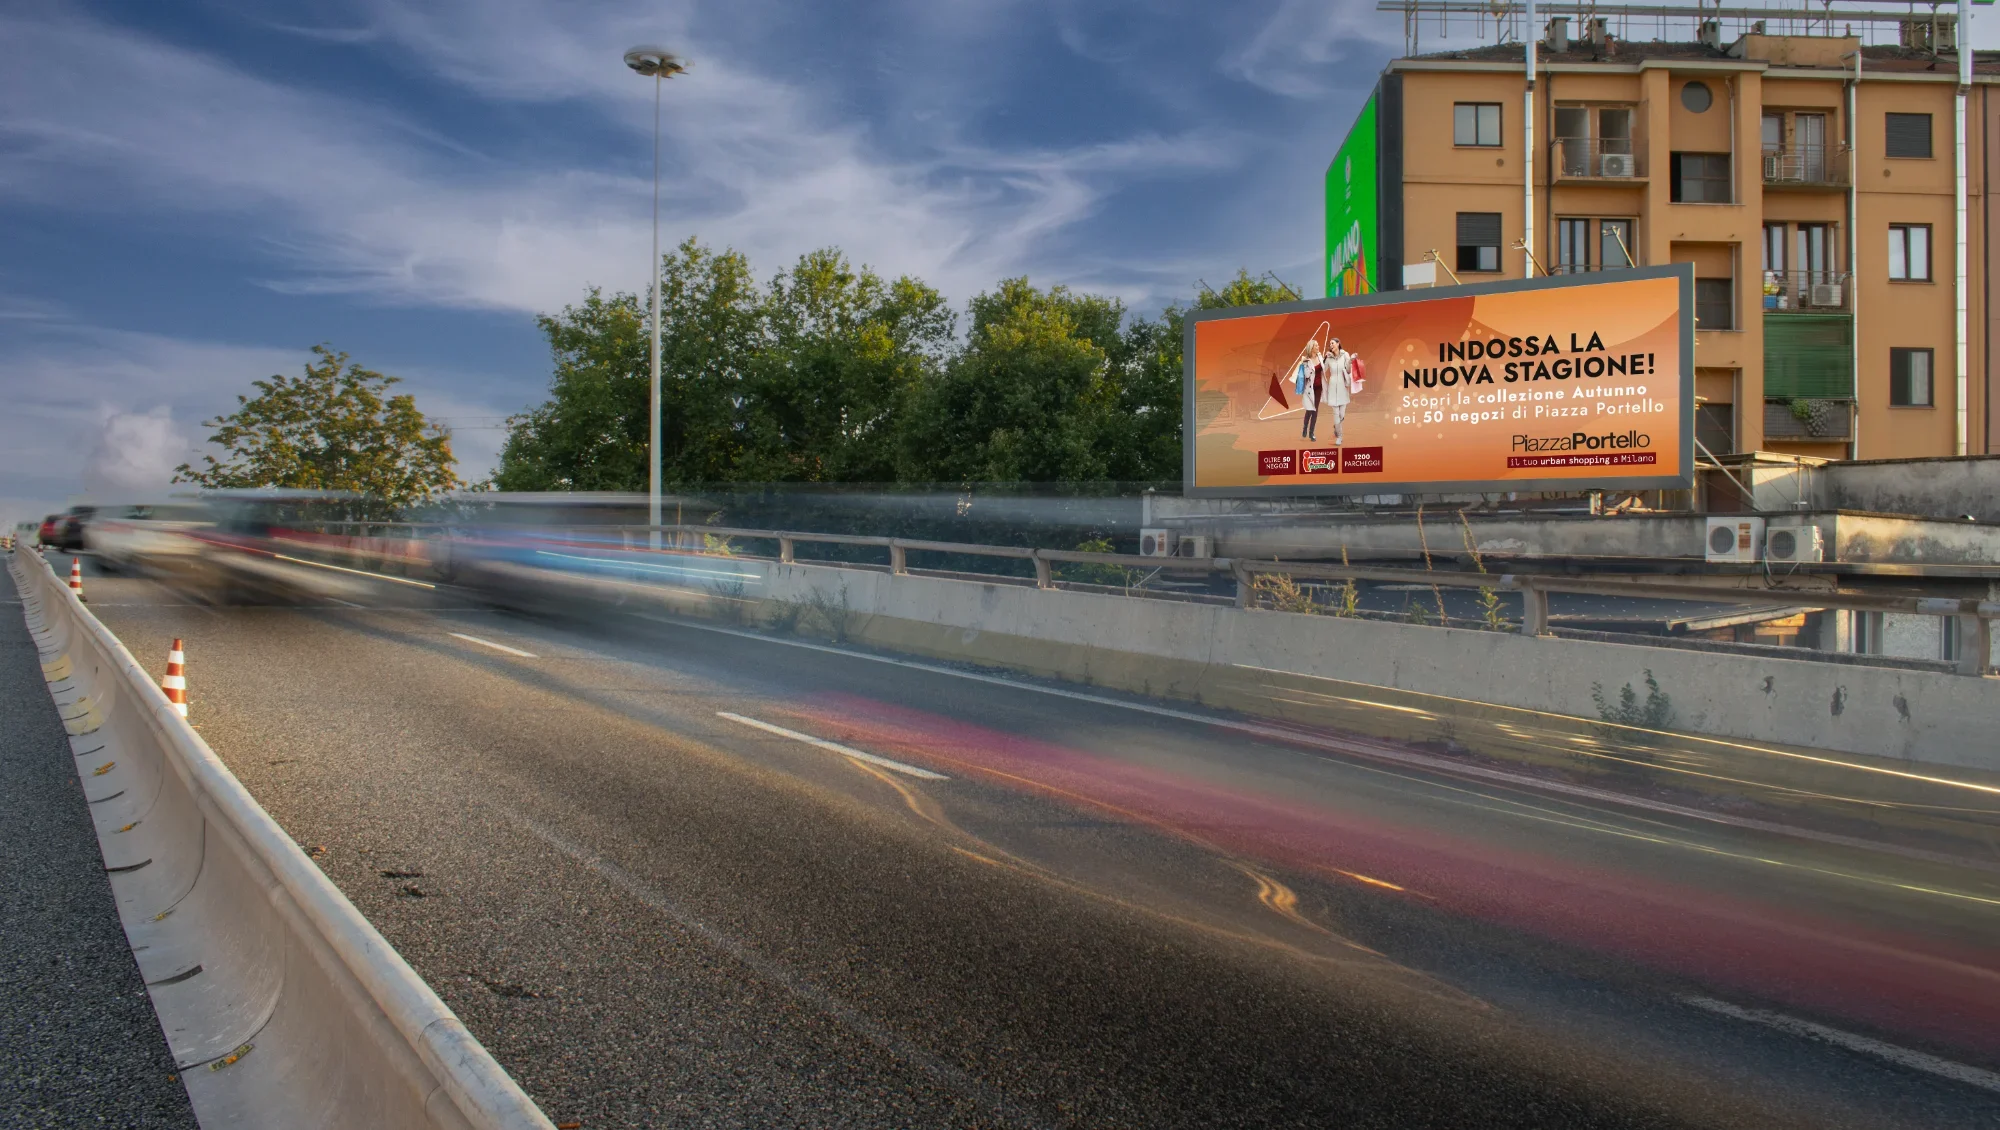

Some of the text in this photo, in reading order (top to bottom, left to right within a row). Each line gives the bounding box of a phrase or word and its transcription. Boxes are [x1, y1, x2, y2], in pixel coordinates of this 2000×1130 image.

[1439, 331, 1605, 362] INDOSSA LA
[1403, 353, 1655, 388] NUOVA STAGIONE!
[1402, 385, 1647, 409] Scopri la collezione Autunno
[1394, 398, 1664, 425] nei 50 negozi di Piazza Portello
[1512, 430, 1650, 452] PiazzaPortello
[1510, 457, 1520, 466] il
[1523, 458, 1538, 466] tuo
[1540, 457, 1566, 465] urban
[1568, 456, 1610, 466] shopping
[1620, 454, 1654, 463] Milano
